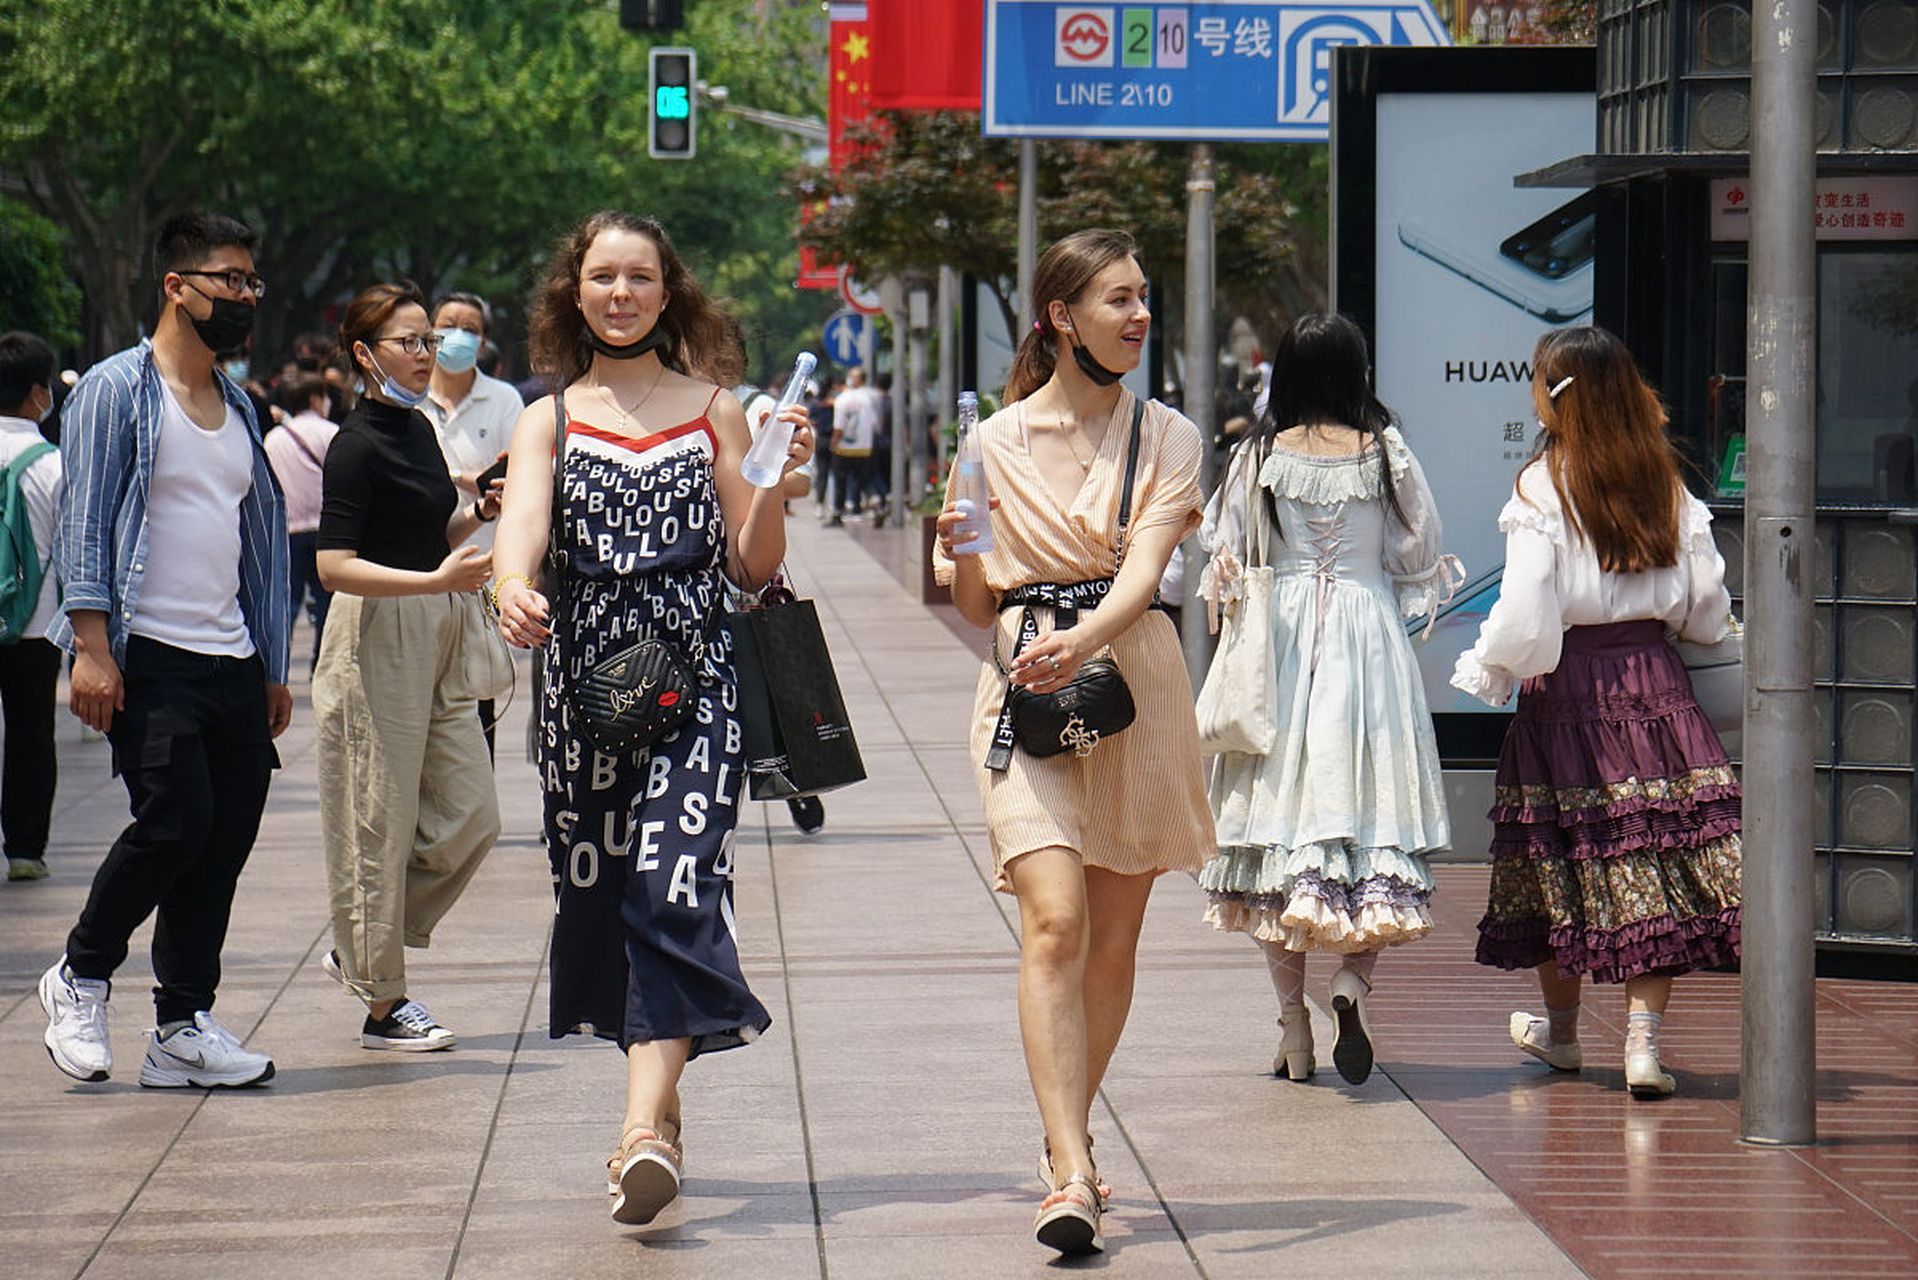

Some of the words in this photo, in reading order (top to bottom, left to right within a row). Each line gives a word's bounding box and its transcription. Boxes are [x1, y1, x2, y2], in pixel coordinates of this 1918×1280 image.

[1128, 25, 1148, 54] 2
[1159, 23, 1184, 54] 10
[1194, 18, 1273, 58] 号线
[1055, 83, 1113, 106] LINE
